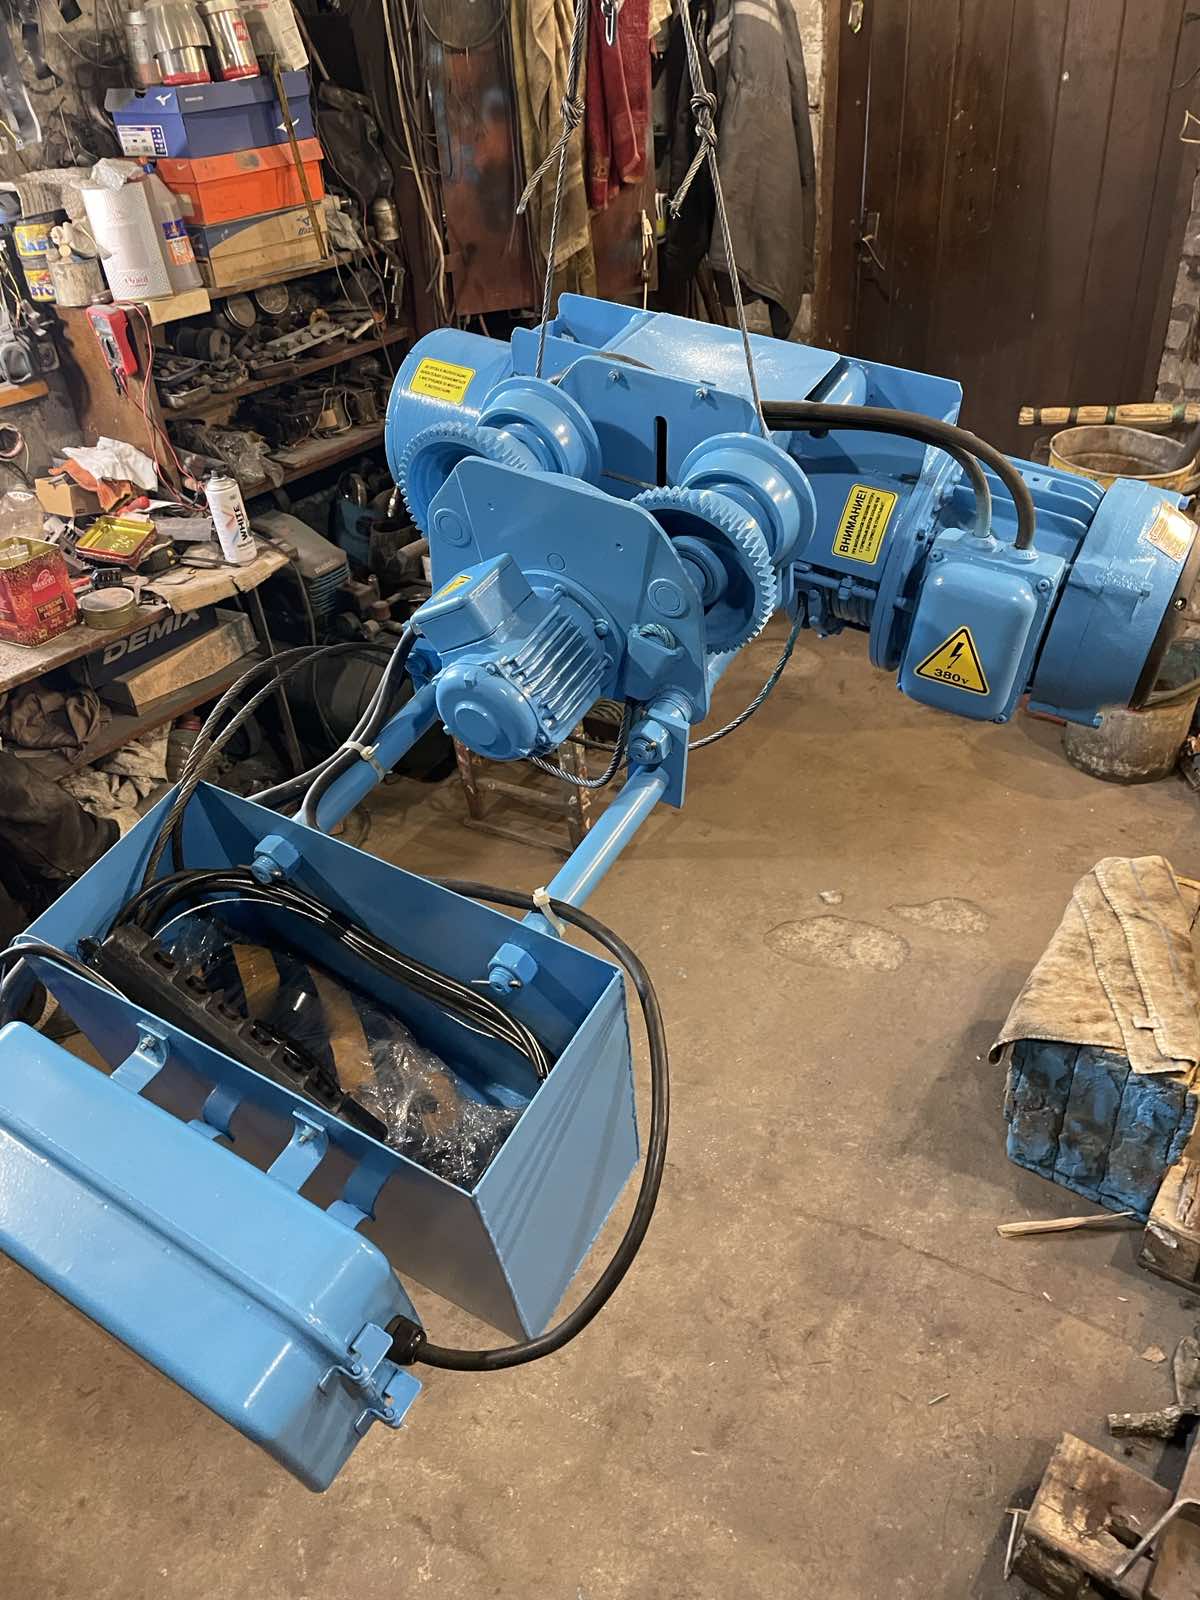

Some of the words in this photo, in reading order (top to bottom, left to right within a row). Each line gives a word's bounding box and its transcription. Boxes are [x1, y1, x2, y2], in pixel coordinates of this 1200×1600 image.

[233, 504, 248, 541] WHITE
[839, 489, 868, 553] ВНИМАНИЕ!
[103, 612, 200, 665] DEMIX
